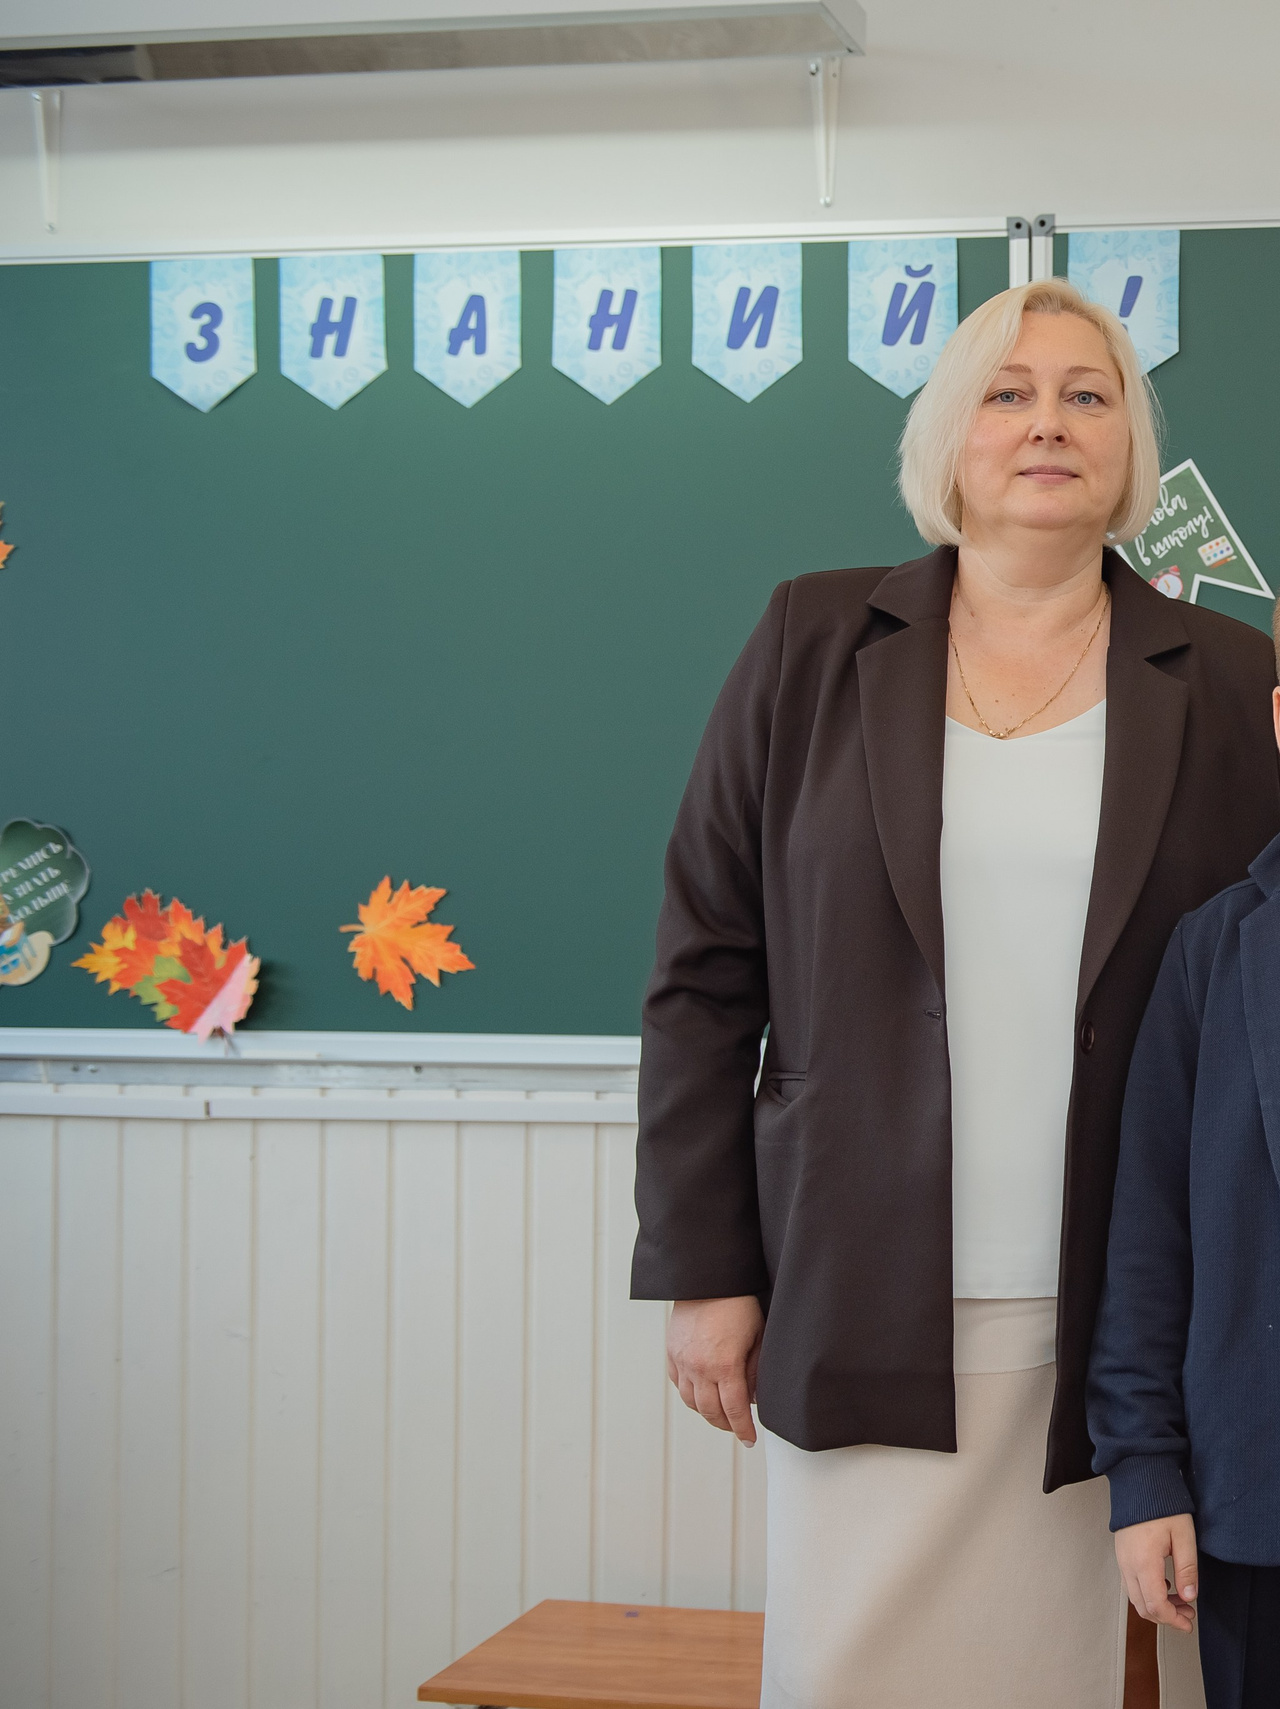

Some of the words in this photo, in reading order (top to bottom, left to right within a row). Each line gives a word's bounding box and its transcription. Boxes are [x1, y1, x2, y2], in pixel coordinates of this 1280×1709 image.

[1141, 484, 1188, 535] ова
[1134, 534, 1152, 566] в
[1150, 505, 1215, 559] школу!
[0, 842, 64, 888] РЕМИСЬ
